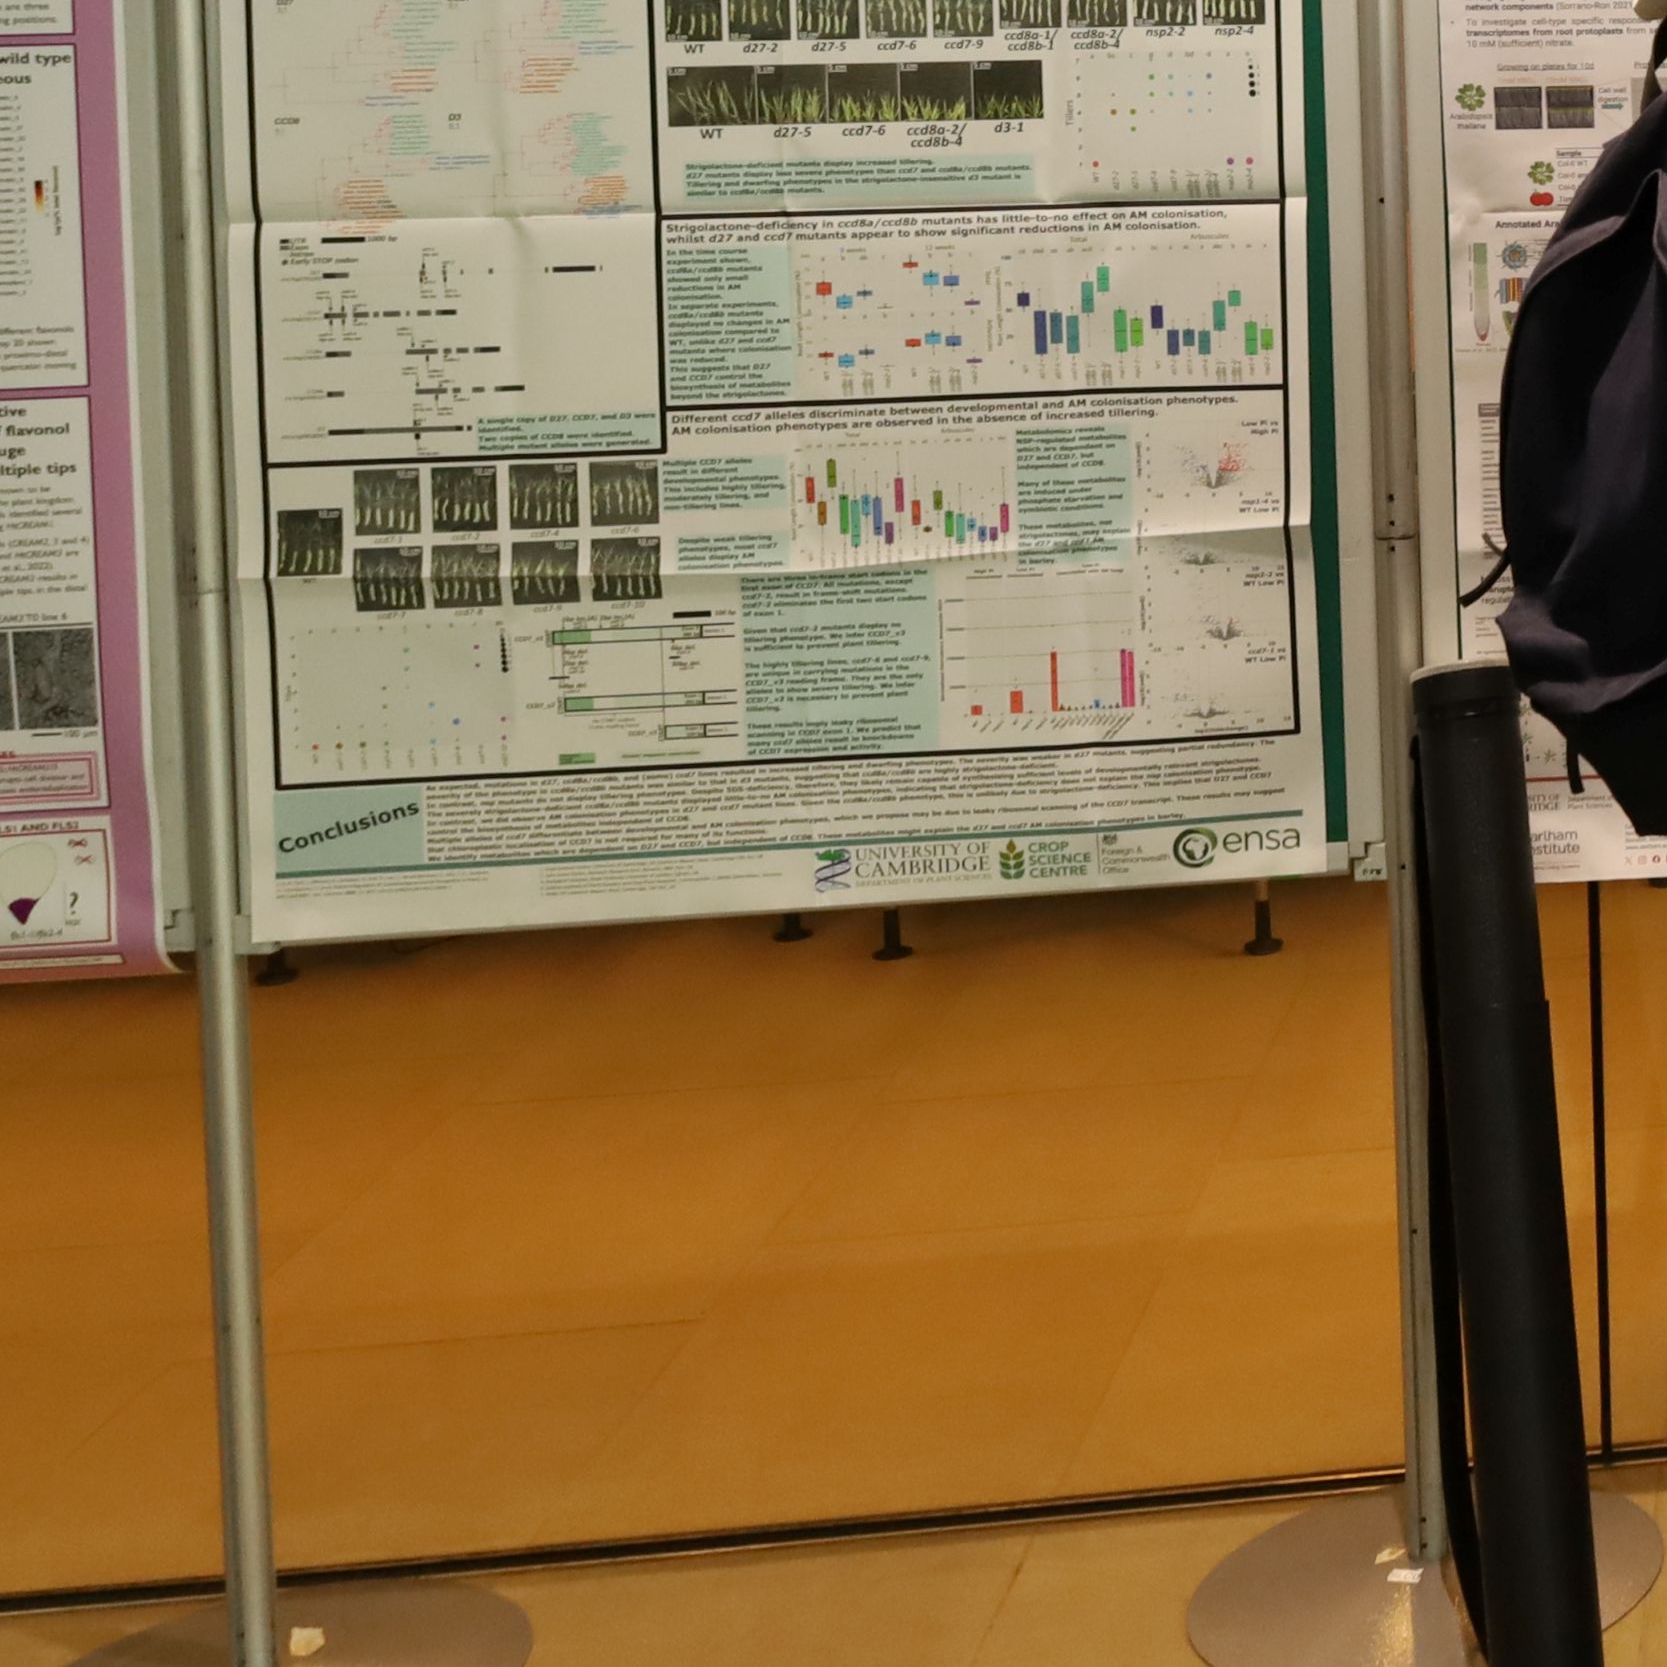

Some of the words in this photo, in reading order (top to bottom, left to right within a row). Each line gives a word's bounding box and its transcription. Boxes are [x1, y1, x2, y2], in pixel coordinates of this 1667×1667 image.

[278, 802, 420, 853] Conclusions
[1027, 840, 1069, 854] CROP
[1221, 826, 1301, 855] ensa
[854, 843, 960, 861] UNIVERSITY
[966, 842, 990, 855] OF
[1028, 852, 1092, 865] SCIENCE
[854, 855, 990, 879] CAMBRIDGE
[1028, 865, 1089, 879] CENTRE
